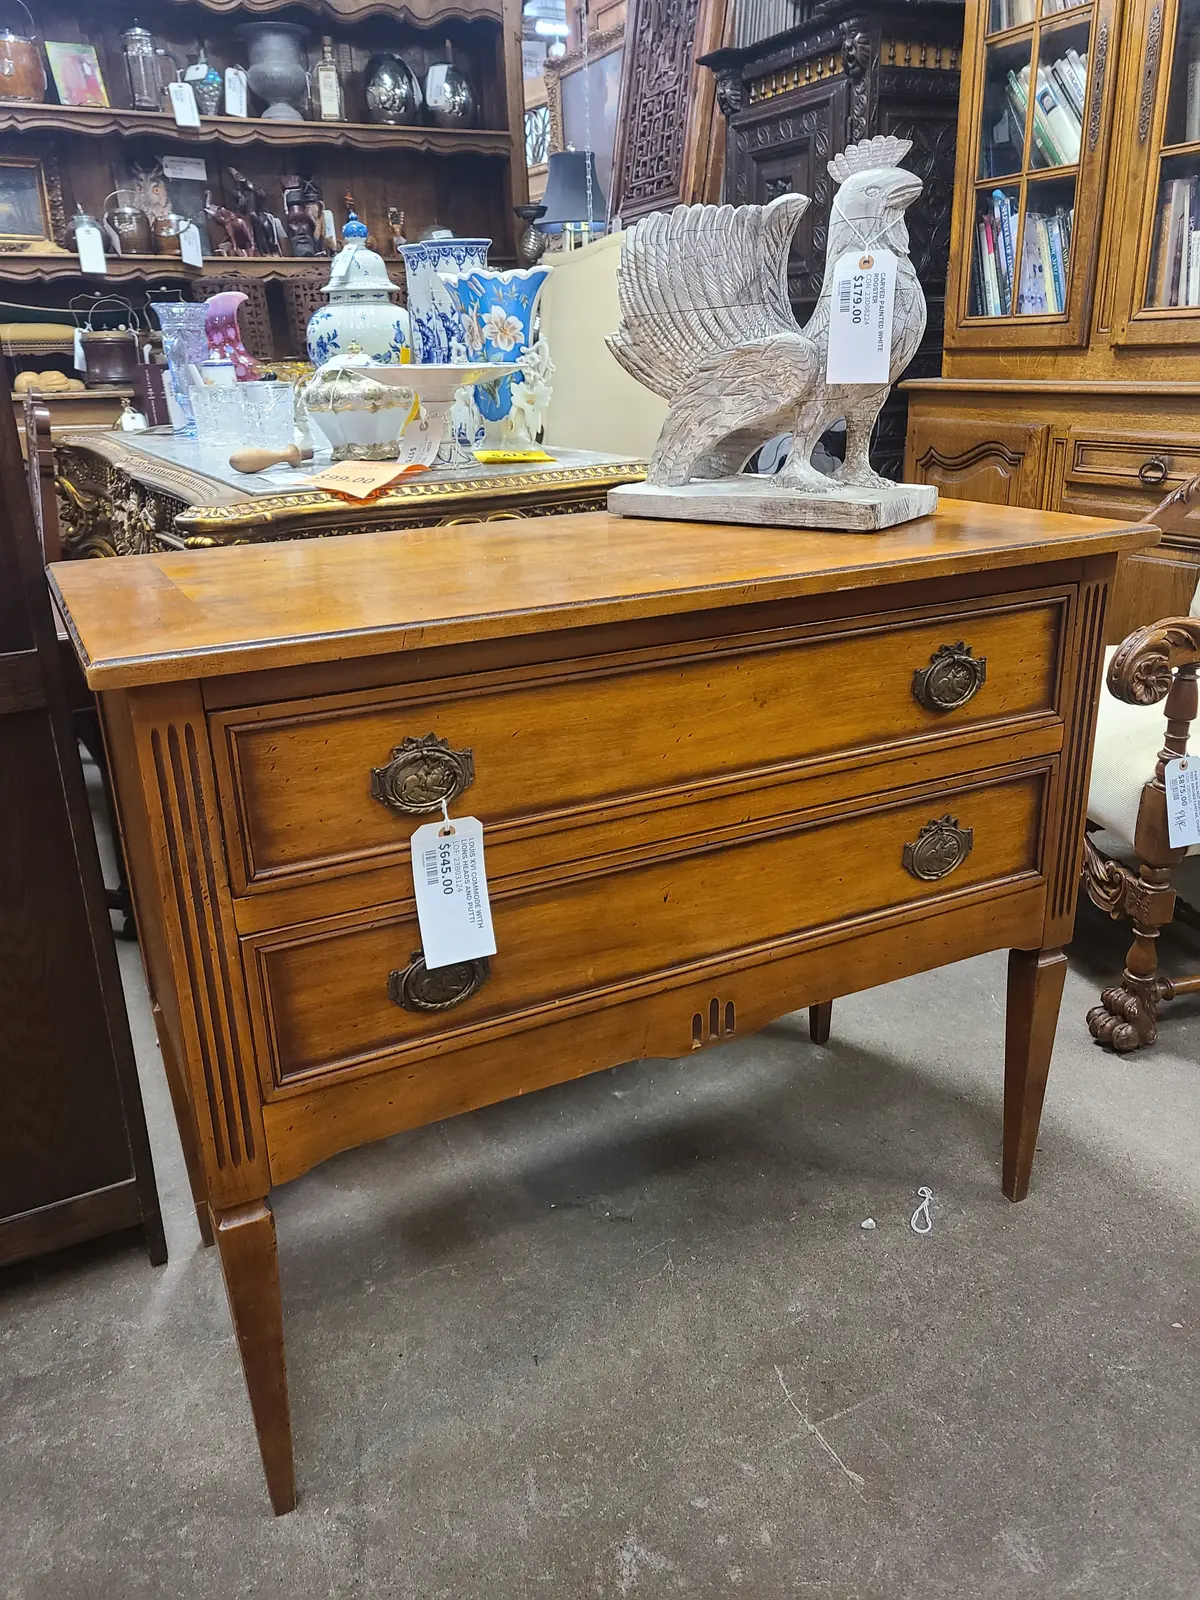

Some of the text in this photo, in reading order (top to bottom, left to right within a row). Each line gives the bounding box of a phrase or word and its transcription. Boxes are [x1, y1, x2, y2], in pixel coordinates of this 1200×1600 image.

[852, 275, 863, 323] $179.00
[316, 474, 376, 484] $99.00
[1178, 774, 1187, 806] $875.00
[468, 838, 476, 857] LOUIS
[469, 859, 477, 870] XVI
[438, 844, 453, 895] $645.00
[454, 858, 462, 892] 23B03124
[462, 861, 470, 884] HEADS
[466, 902, 475, 923] PUTTI
[471, 872, 481, 909] COMMODE
